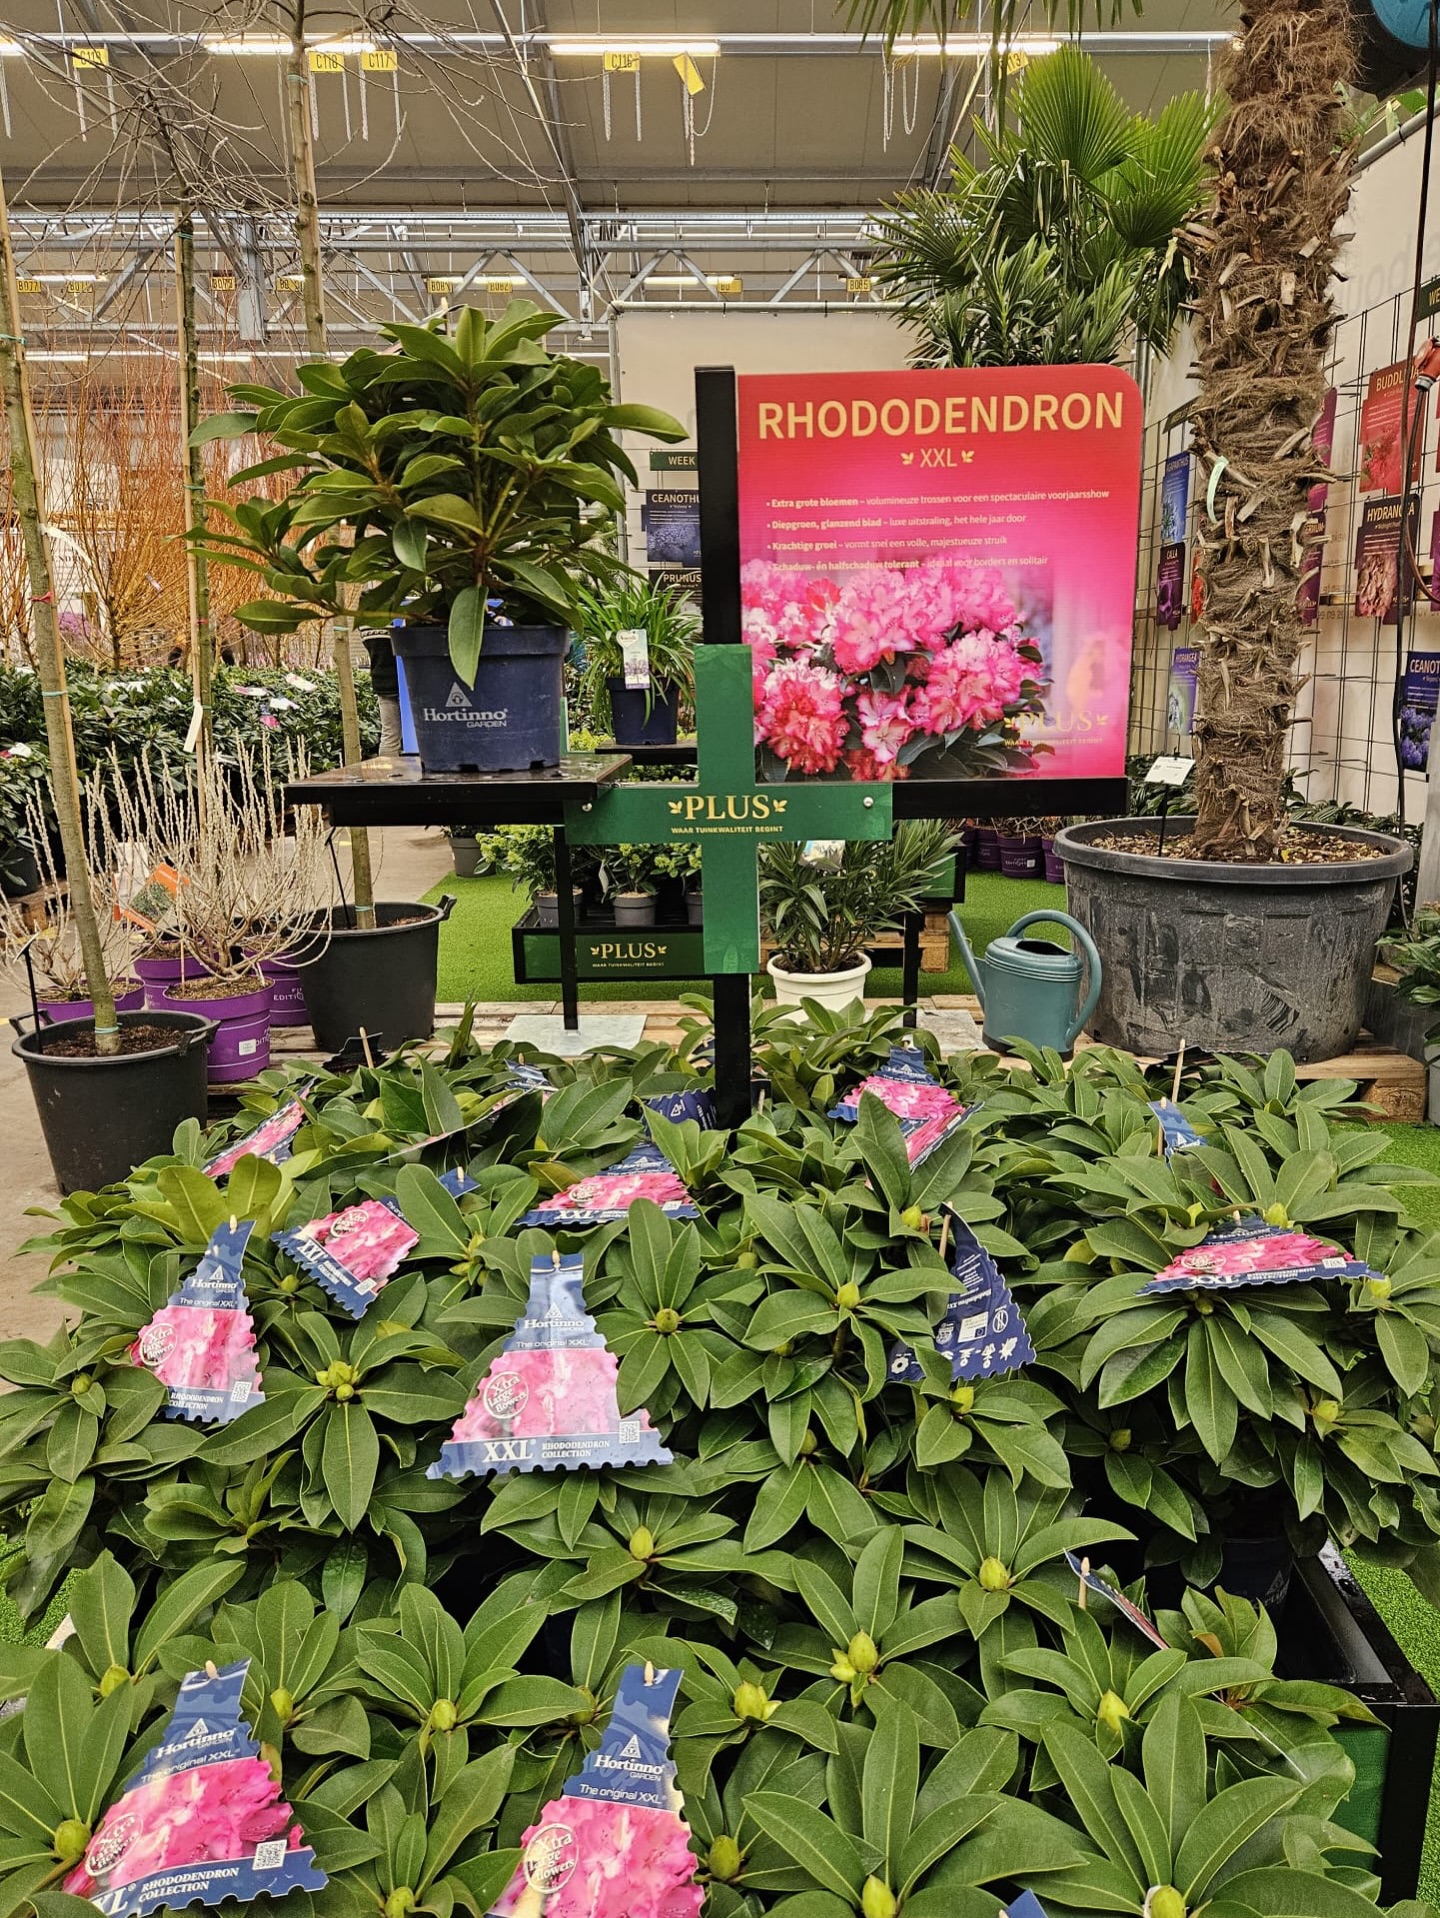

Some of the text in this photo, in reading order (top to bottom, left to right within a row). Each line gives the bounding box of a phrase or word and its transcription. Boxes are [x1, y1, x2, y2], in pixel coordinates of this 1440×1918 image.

[368, 52, 389, 68] C117
[611, 53, 632, 68] C116
[758, 391, 1124, 440] RHODODENDRON
[668, 456, 696, 466] WEEK
[920, 448, 957, 468] XXL
[771, 489, 1110, 509] Extra grote bloemen volumineuze trossen voor een spectaculaire voorjaarsshow
[772, 514, 1026, 531] Diepgroen, glanzend blad luxe uitstraling, het hele jaar door
[772, 536, 1007, 552] Krachtige groei vormt snel een volle, majestueuze struik
[884, 559, 920, 569] tolerant
[1007, 558, 1018, 567] en
[1019, 555, 1048, 566] solitair
[663, 574, 702, 583] PRUNUS
[1409, 659, 1440, 674] CEANOT
[423, 708, 507, 722] Hortinno
[1018, 711, 1092, 733] PLUS
[466, 720, 507, 729] GARDEN
[683, 794, 770, 820] PLUS
[695, 826, 753, 834] TUINKWALITEIT
[600, 943, 656, 959] PLUS
[190, 1278, 238, 1289] Hortinno
[180, 1297, 235, 1308] The original XXL
[524, 1318, 585, 1329] Hortinno
[148, 1327, 173, 1344] Xtra
[516, 1338, 590, 1349] The original XXL
[489, 1375, 521, 1397] Xtra
[170, 1392, 225, 1404] RHODODENDRON
[482, 1439, 533, 1463] XXL
[542, 1440, 611, 1451] RHODODENDRON
[541, 1449, 592, 1459] COLLECTION
[155, 1728, 235, 1759] Hortinno
[197, 1736, 233, 1749] GARDEN
[166, 1756, 207, 1774] original
[208, 1750, 235, 1762] XXL
[594, 1754, 663, 1775] Hortinno
[630, 1771, 661, 1782] GARDEN
[580, 1783, 662, 1804] The original XXL
[537, 1829, 573, 1854] Xtra
[141, 1867, 240, 1893] RHODODENDRON
[138, 1881, 210, 1904] COLLECTION
[91, 1887, 128, 1916] XL
